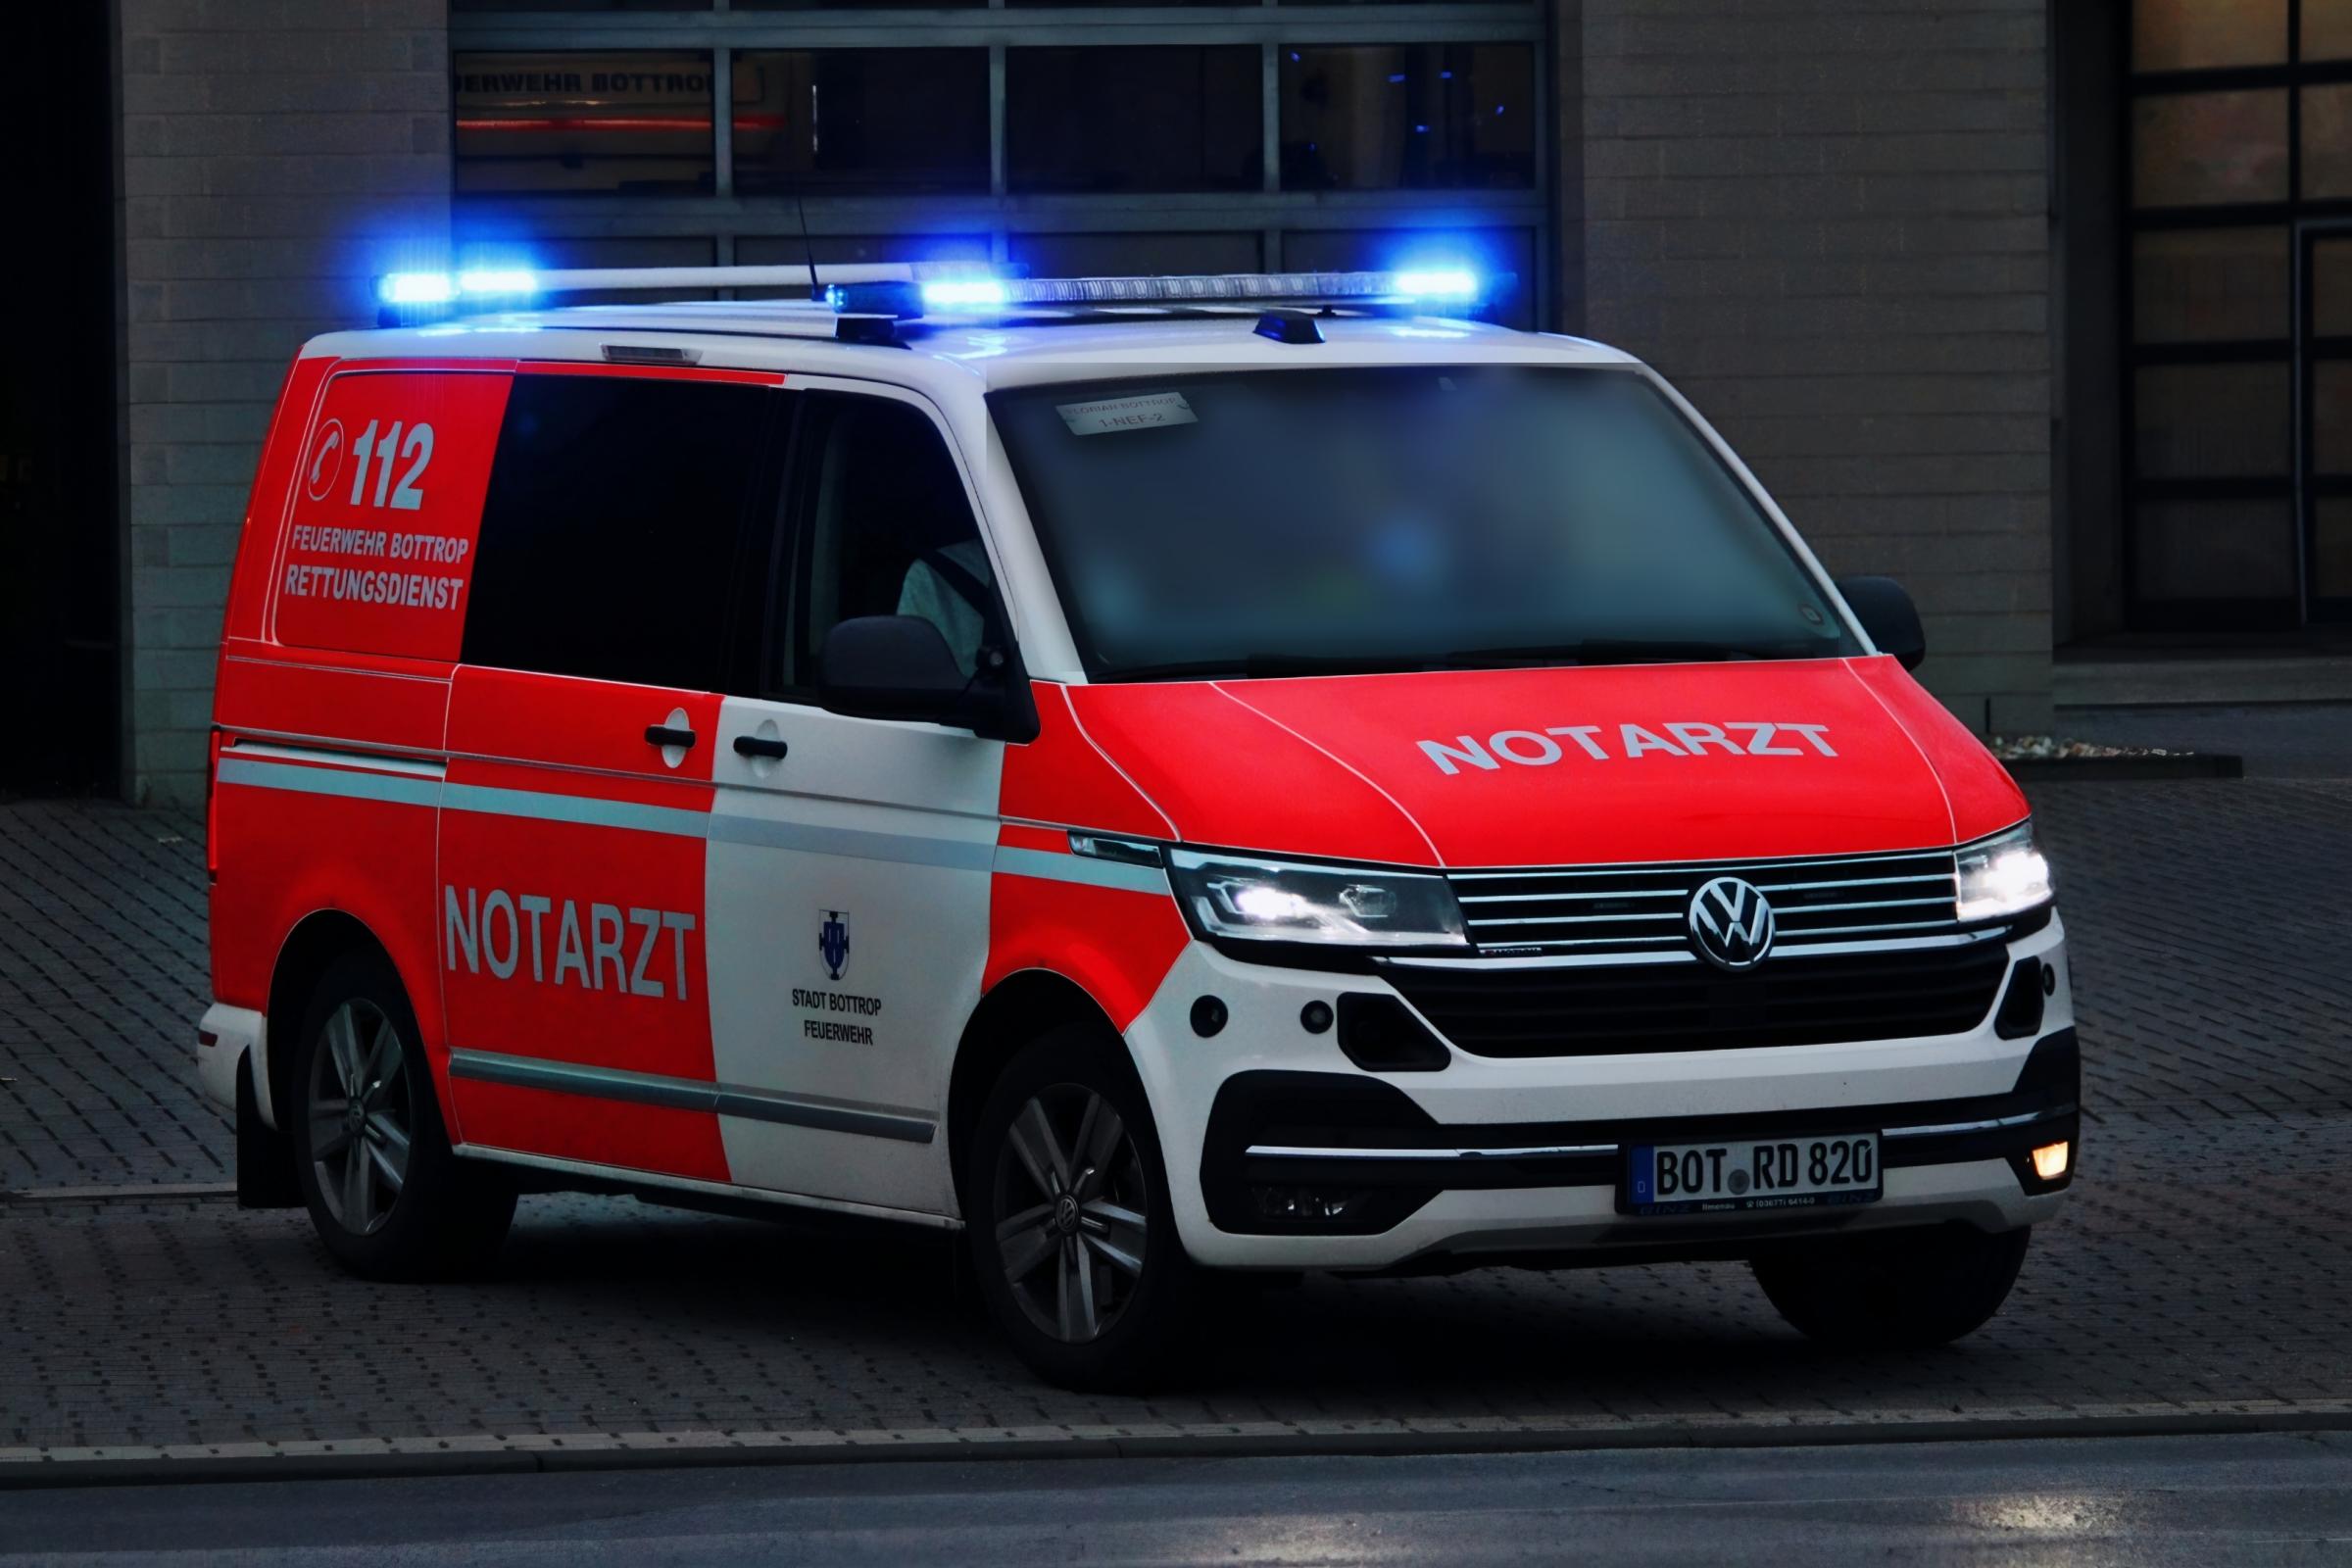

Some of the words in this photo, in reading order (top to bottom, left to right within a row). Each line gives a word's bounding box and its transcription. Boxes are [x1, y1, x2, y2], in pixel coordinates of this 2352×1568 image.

[350, 419, 434, 511] 112
[292, 524, 387, 557] FEUERWEHR
[390, 532, 469, 564] BOTTROP
[284, 564, 465, 611] RETTUNGSDIENST
[1415, 722, 1838, 775] NOTARZT
[445, 885, 696, 1002] NOTARZT
[792, 988, 827, 1009] STADT
[829, 993, 882, 1016] BOTTROP
[804, 1020, 873, 1046] FEUERWEHR
[1656, 1149, 1728, 1195] BOT
[1753, 1143, 1798, 1190] RD
[1808, 1140, 1873, 1187] 820
